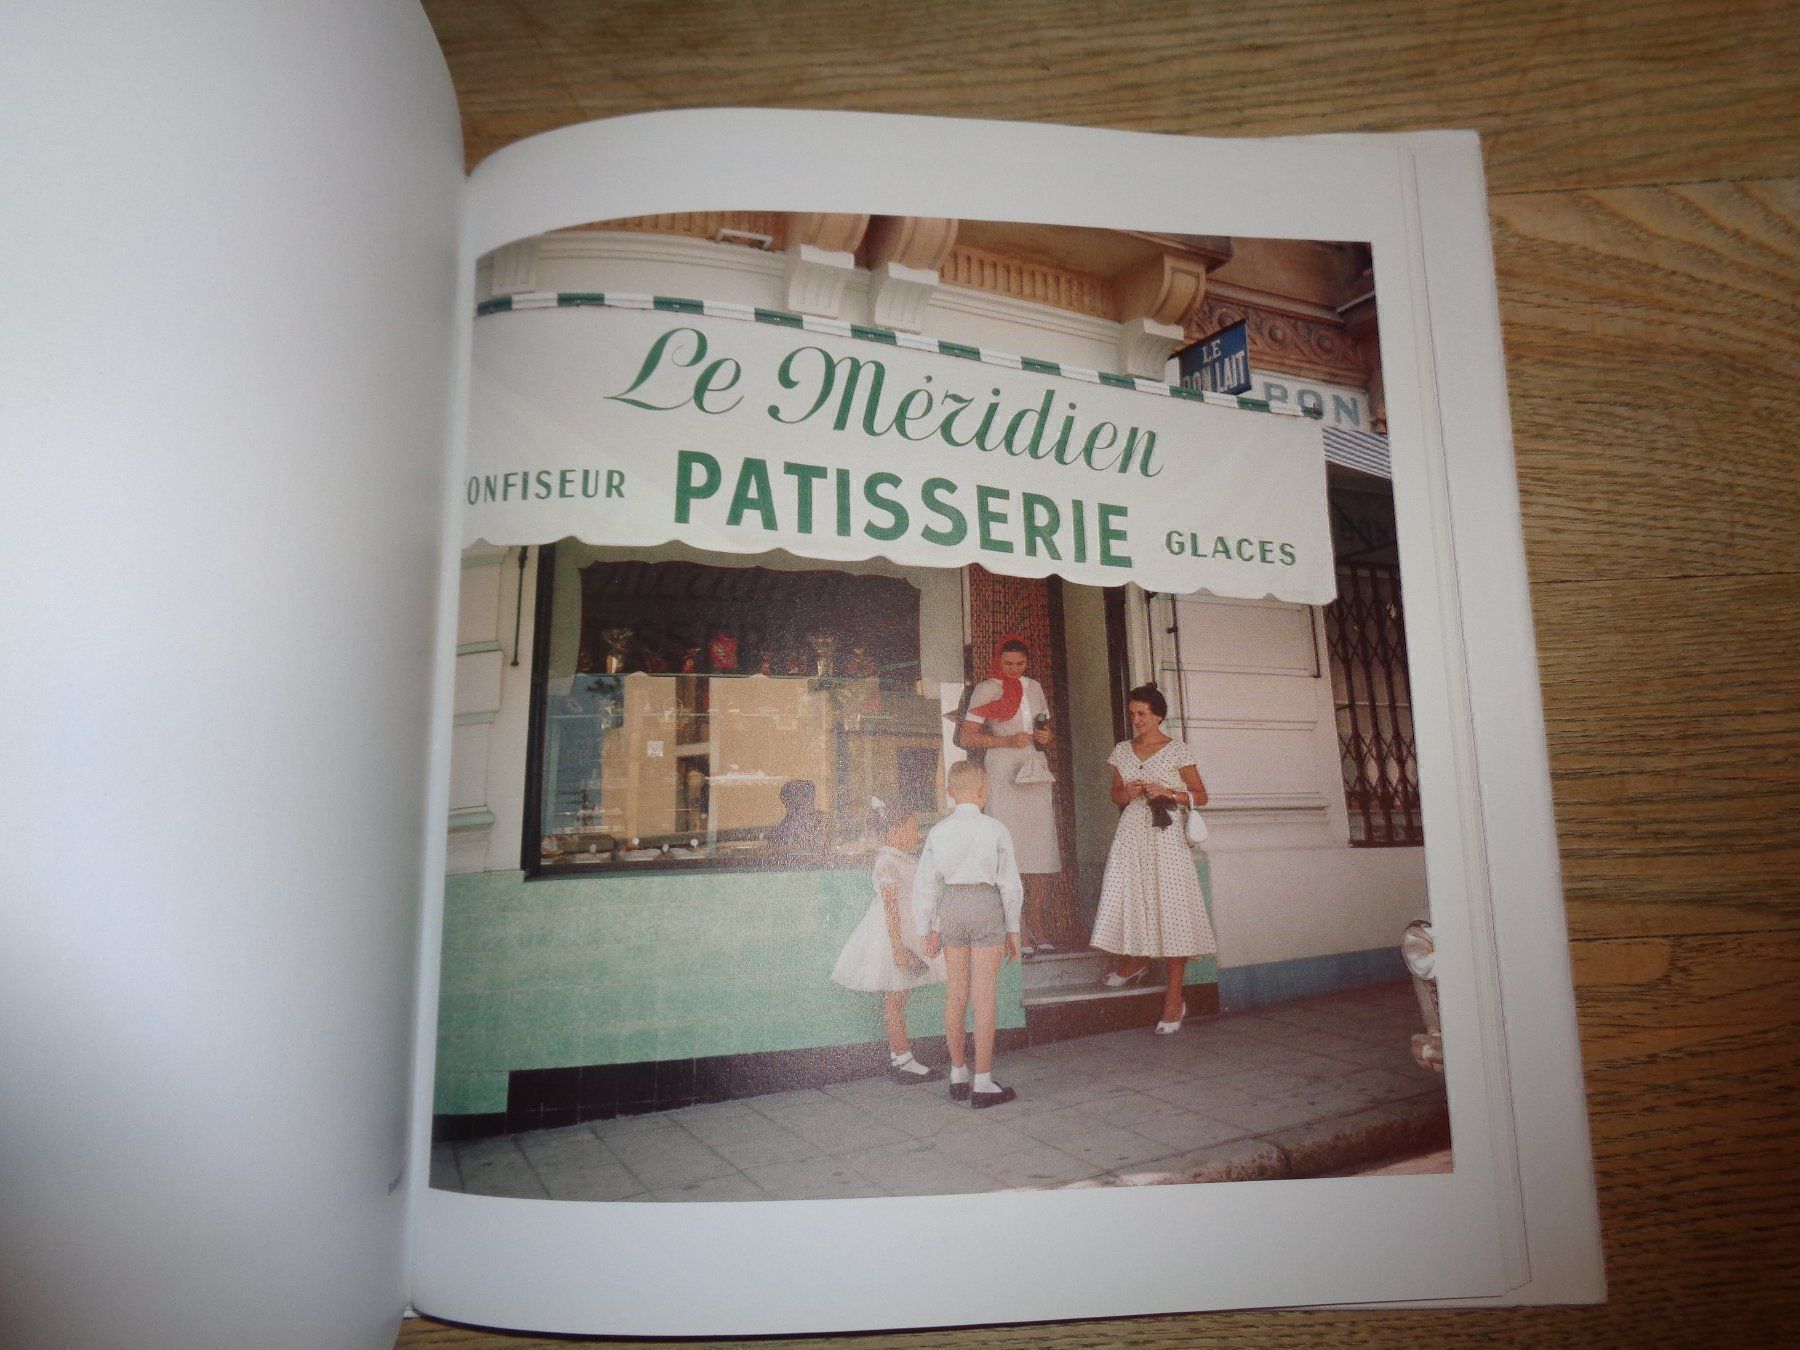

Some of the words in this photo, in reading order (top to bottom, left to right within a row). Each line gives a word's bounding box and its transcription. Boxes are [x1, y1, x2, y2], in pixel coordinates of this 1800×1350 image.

[1202, 339, 1221, 364] LE
[1214, 350, 1246, 393] LAIT
[603, 327, 744, 414] Le
[767, 346, 1163, 477] Méridien
[674, 450, 1133, 569] PATISSERIE
[1165, 530, 1297, 566] GLACES
